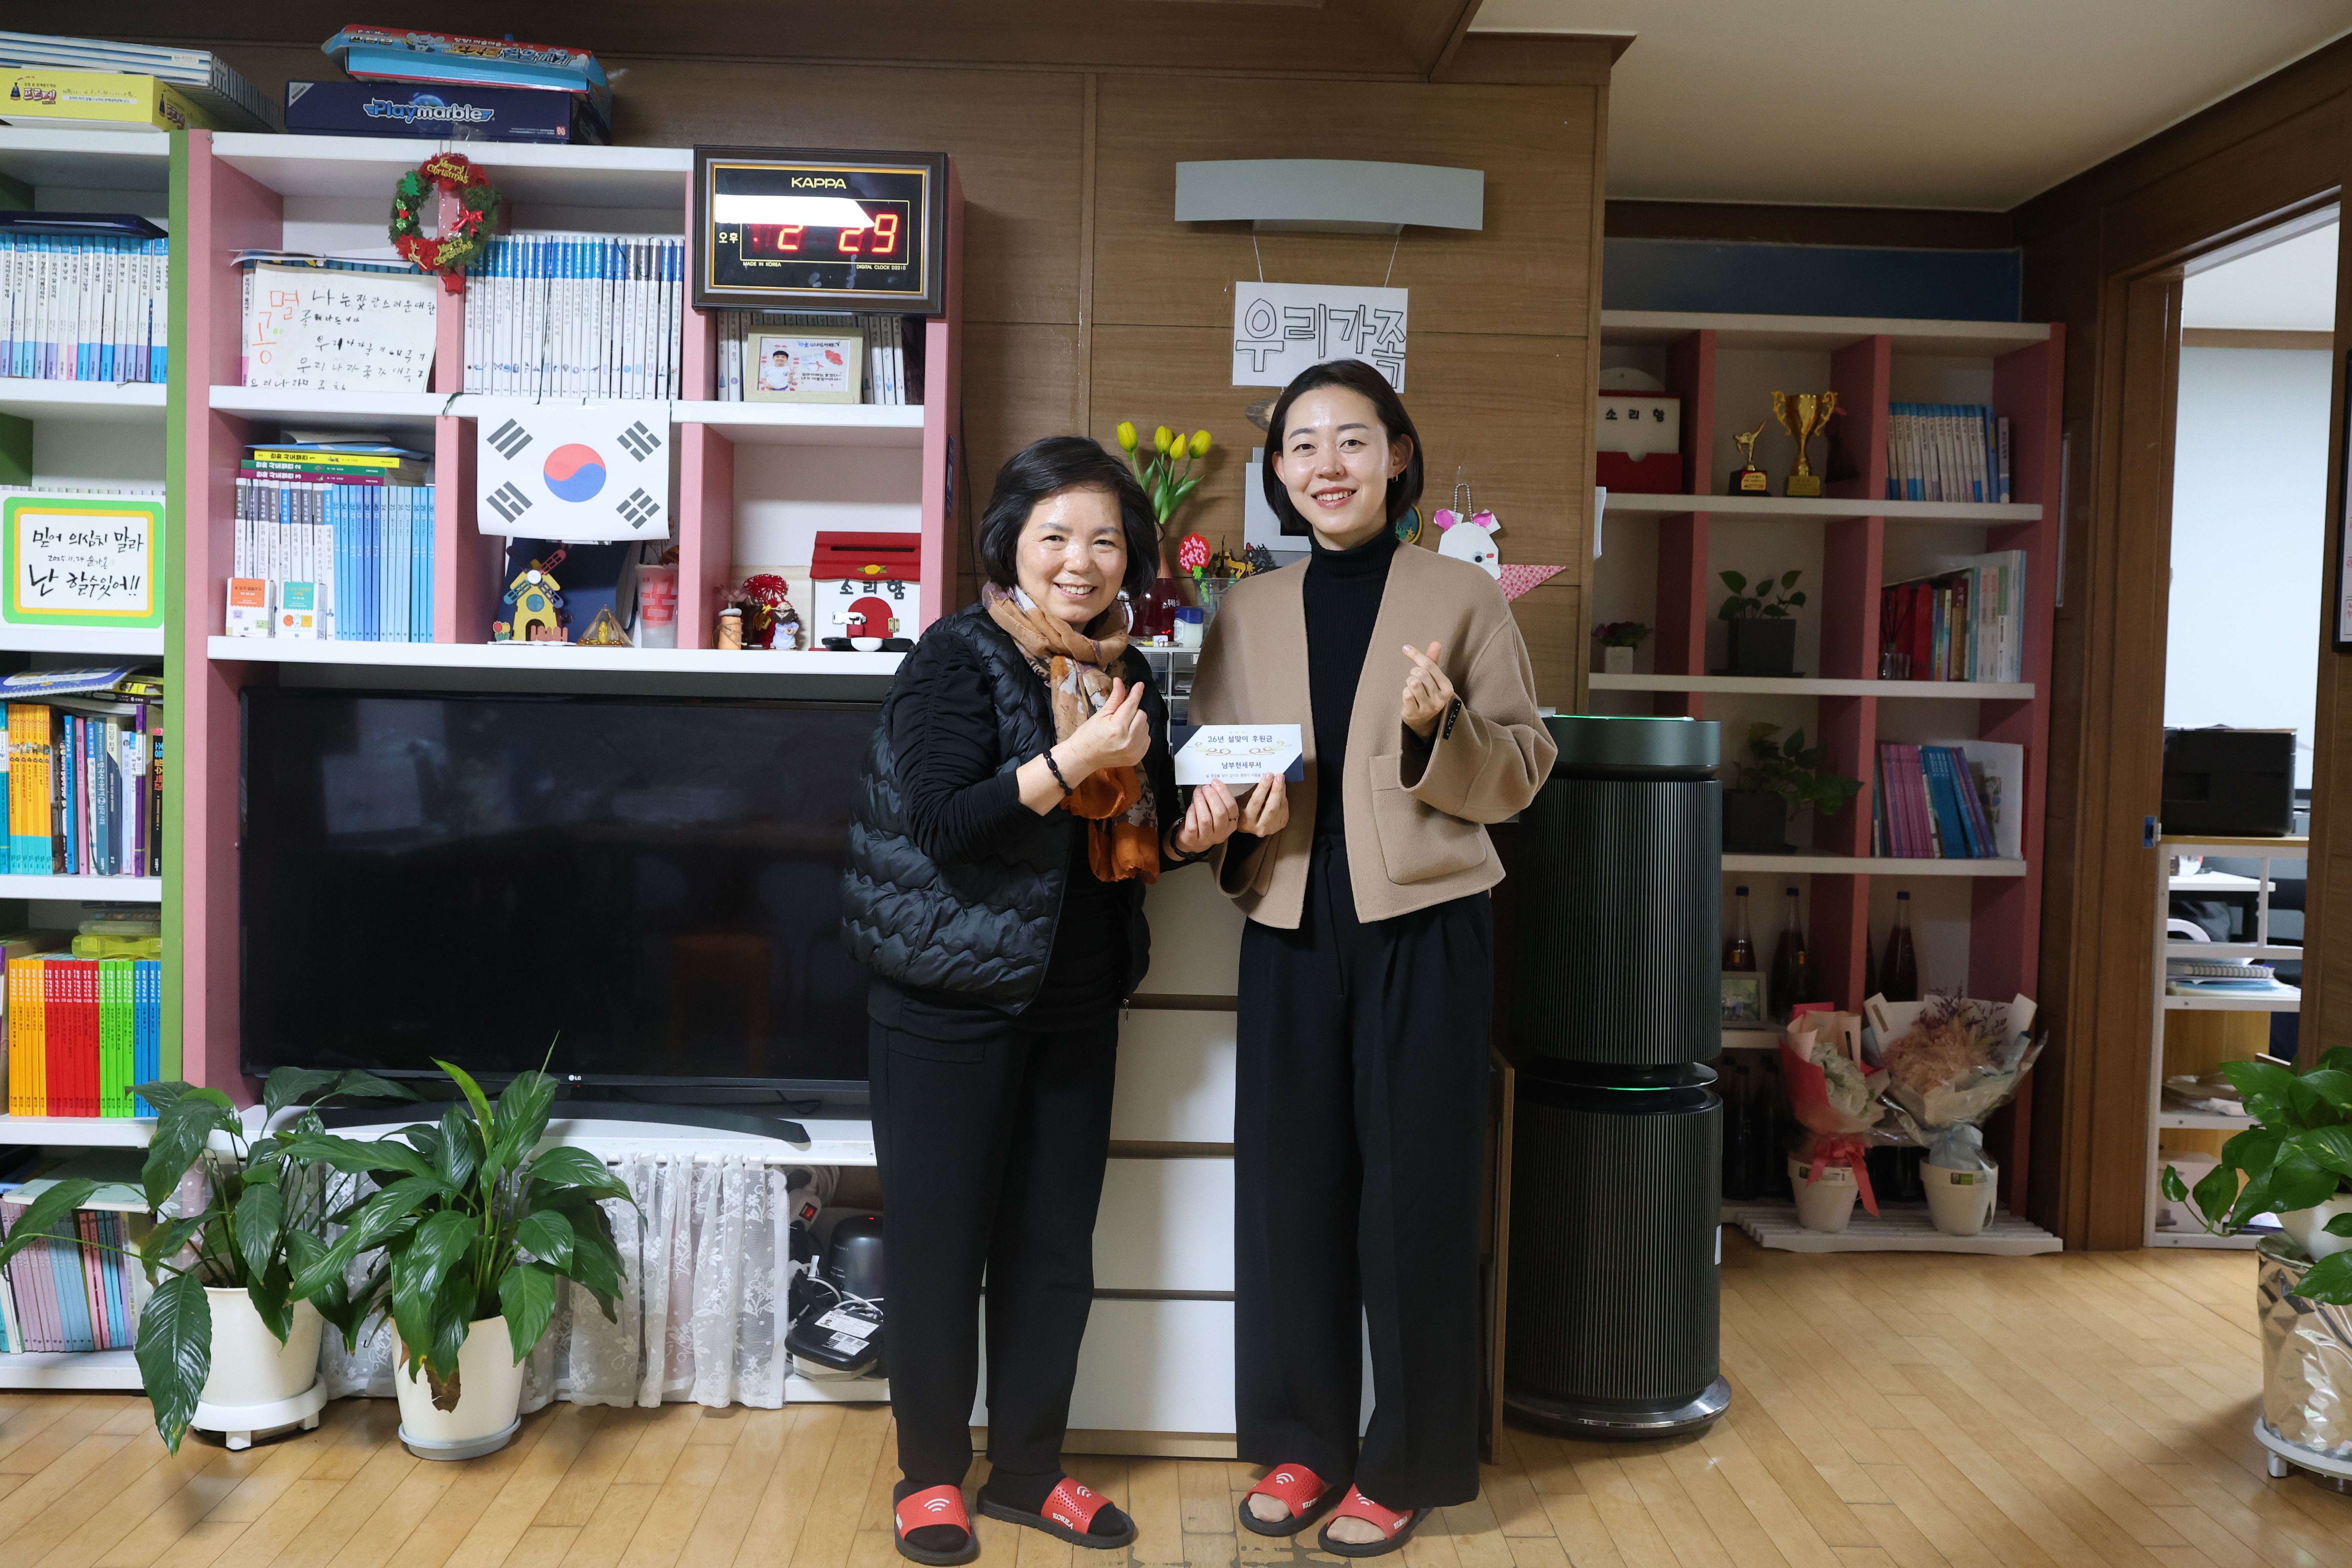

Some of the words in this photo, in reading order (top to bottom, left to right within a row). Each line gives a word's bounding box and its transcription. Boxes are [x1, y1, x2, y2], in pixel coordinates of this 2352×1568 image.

[372, 99, 484, 123] Playmarble
[427, 164, 468, 183] Christmas
[439, 158, 465, 173] Merry
[791, 177, 847, 189] KAPPA
[719, 232, 738, 244] 오후
[1236, 298, 1406, 390] 우리가족
[1606, 408, 1665, 422] 소리함
[33, 526, 62, 548] 믿어
[69, 530, 108, 548] 의심치
[114, 526, 144, 553] 말라
[29, 564, 59, 597] 난
[840, 579, 906, 600] 소리함
[109, 742, 114, 752] 표현
[155, 742, 163, 757] 초등
[154, 759, 163, 774] 필수
[1052, 1513, 1074, 1530] KOREA
